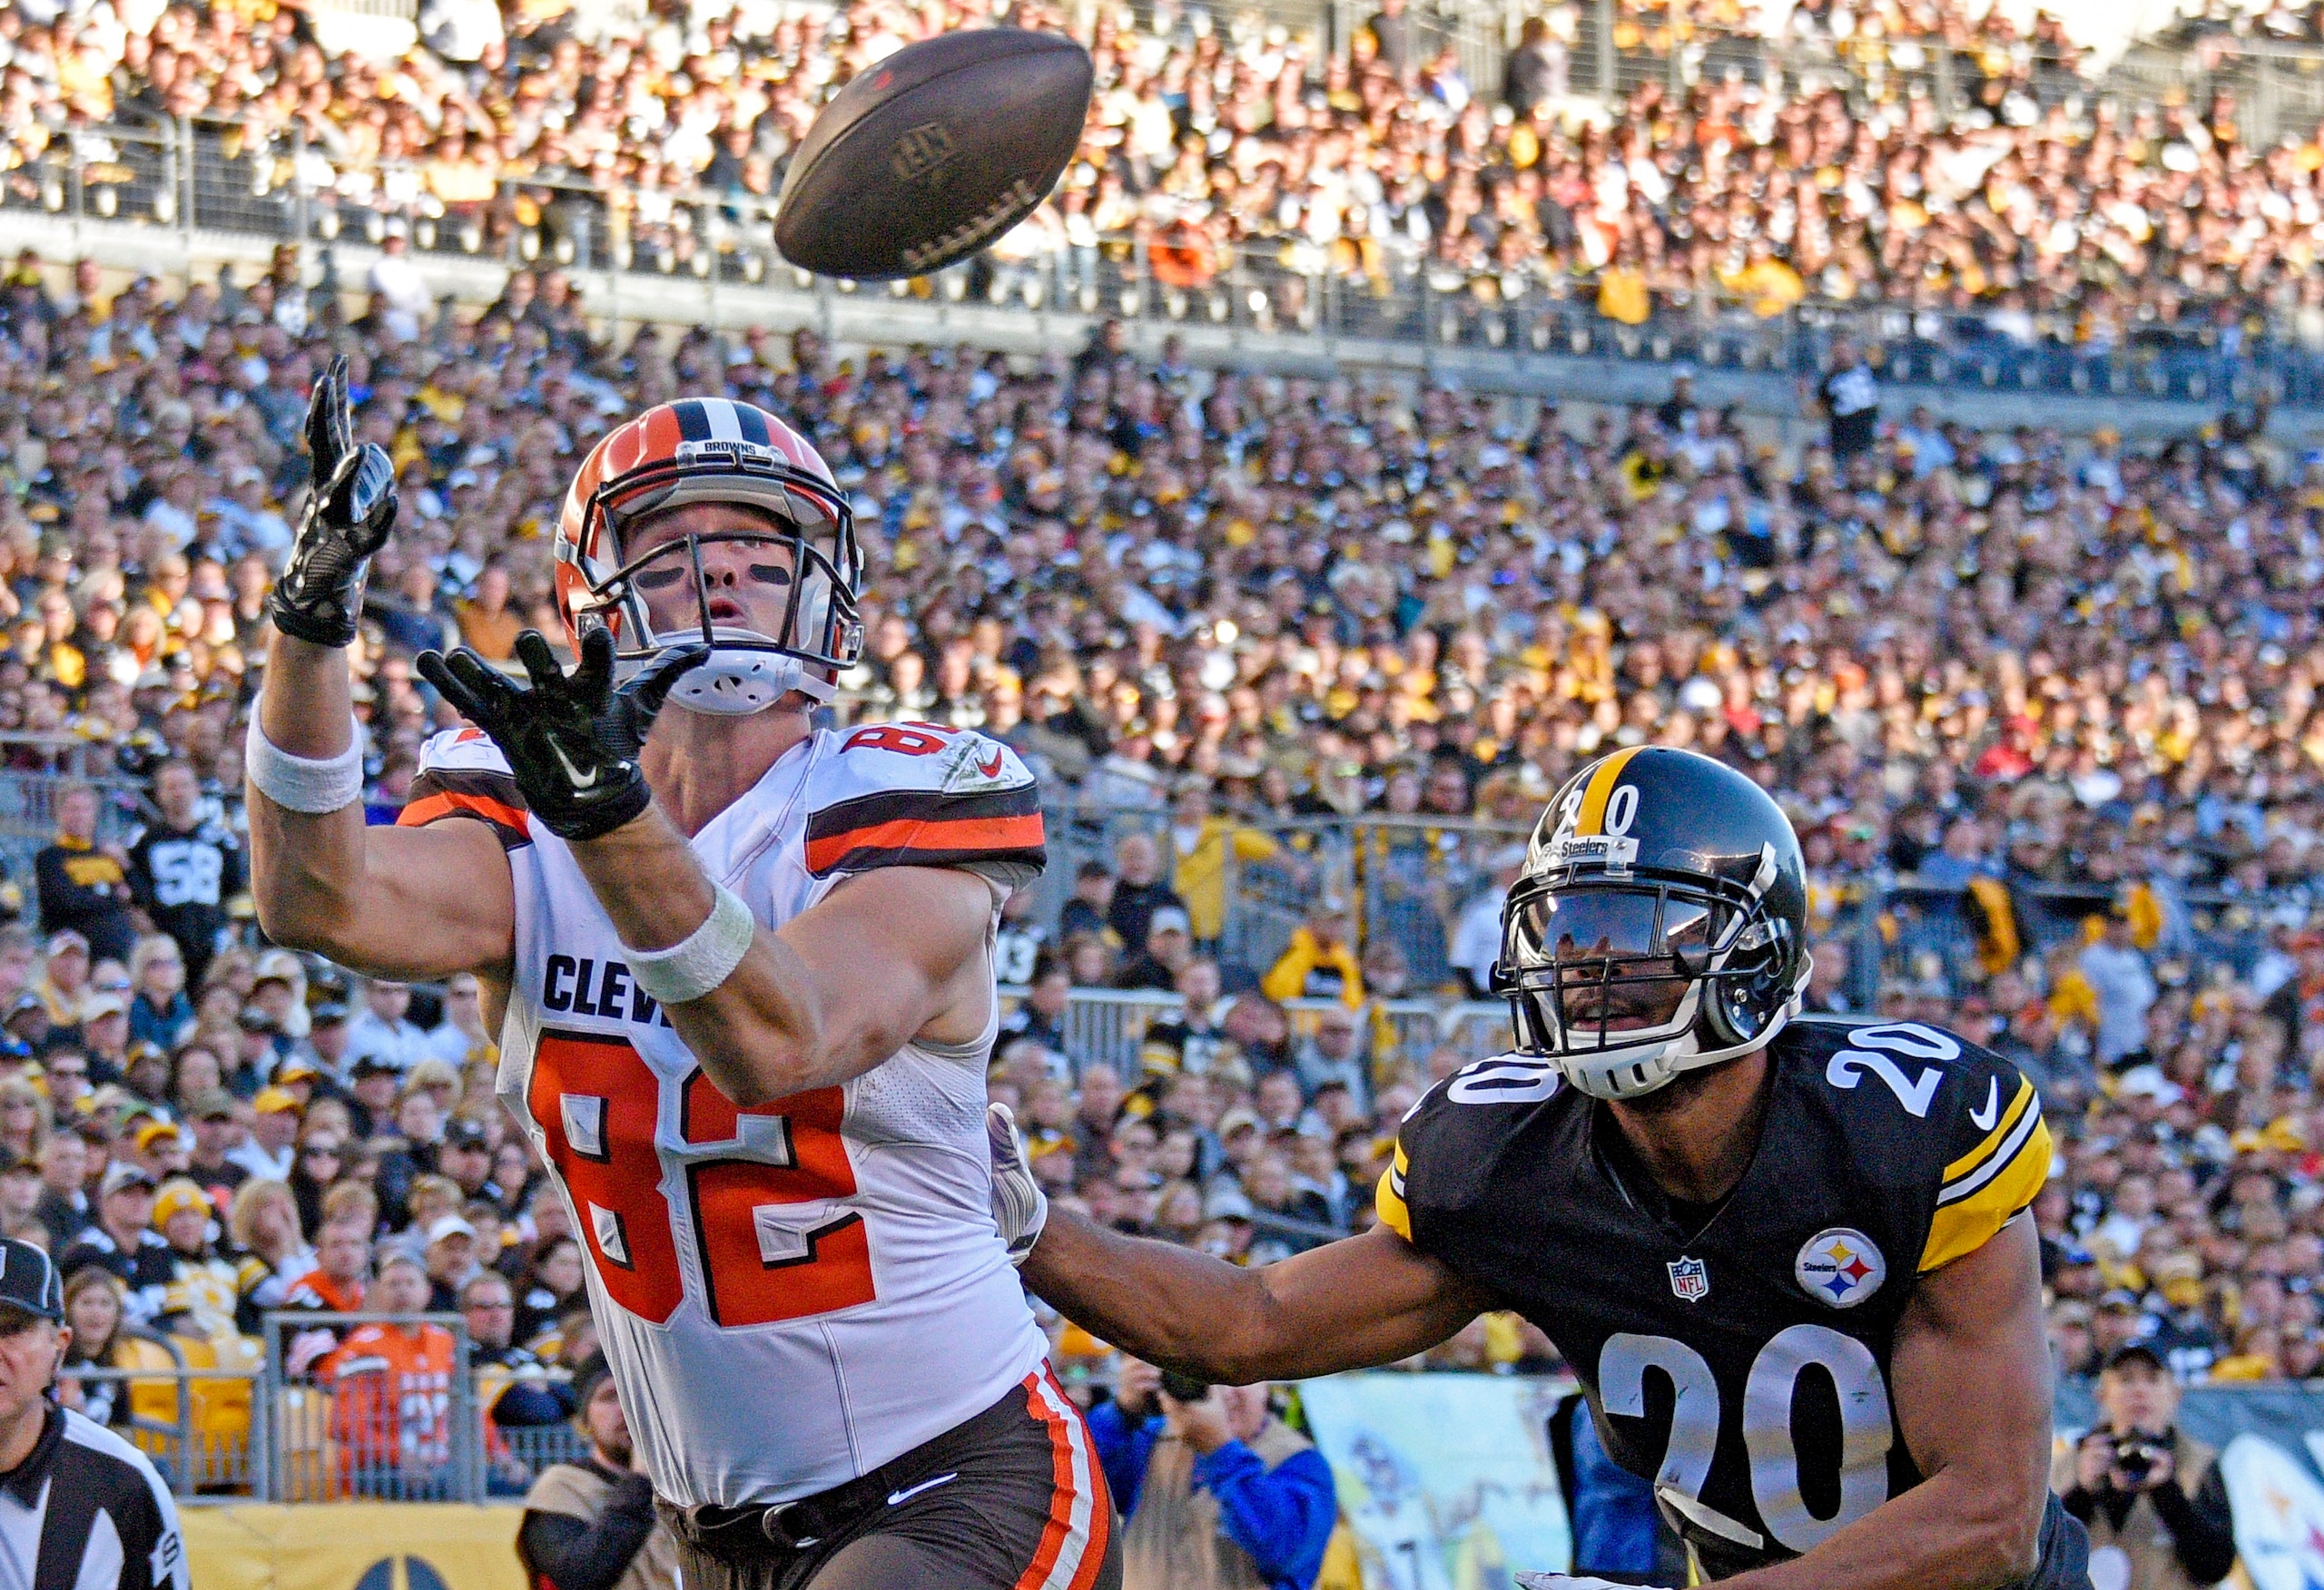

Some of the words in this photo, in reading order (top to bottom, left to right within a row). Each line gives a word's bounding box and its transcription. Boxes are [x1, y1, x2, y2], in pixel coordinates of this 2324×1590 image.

[704, 441, 756, 455] BROWNS
[840, 721, 960, 755] 8
[1551, 784, 1640, 846] 20
[150, 839, 224, 906] 58
[1561, 838, 1609, 858] Steelers
[543, 953, 675, 1028] CLEV
[1826, 1022, 1961, 1118] 20
[528, 1026, 876, 1328] 82
[1677, 1276, 1703, 1294] NFL
[1598, 1323, 1894, 1556] 20
